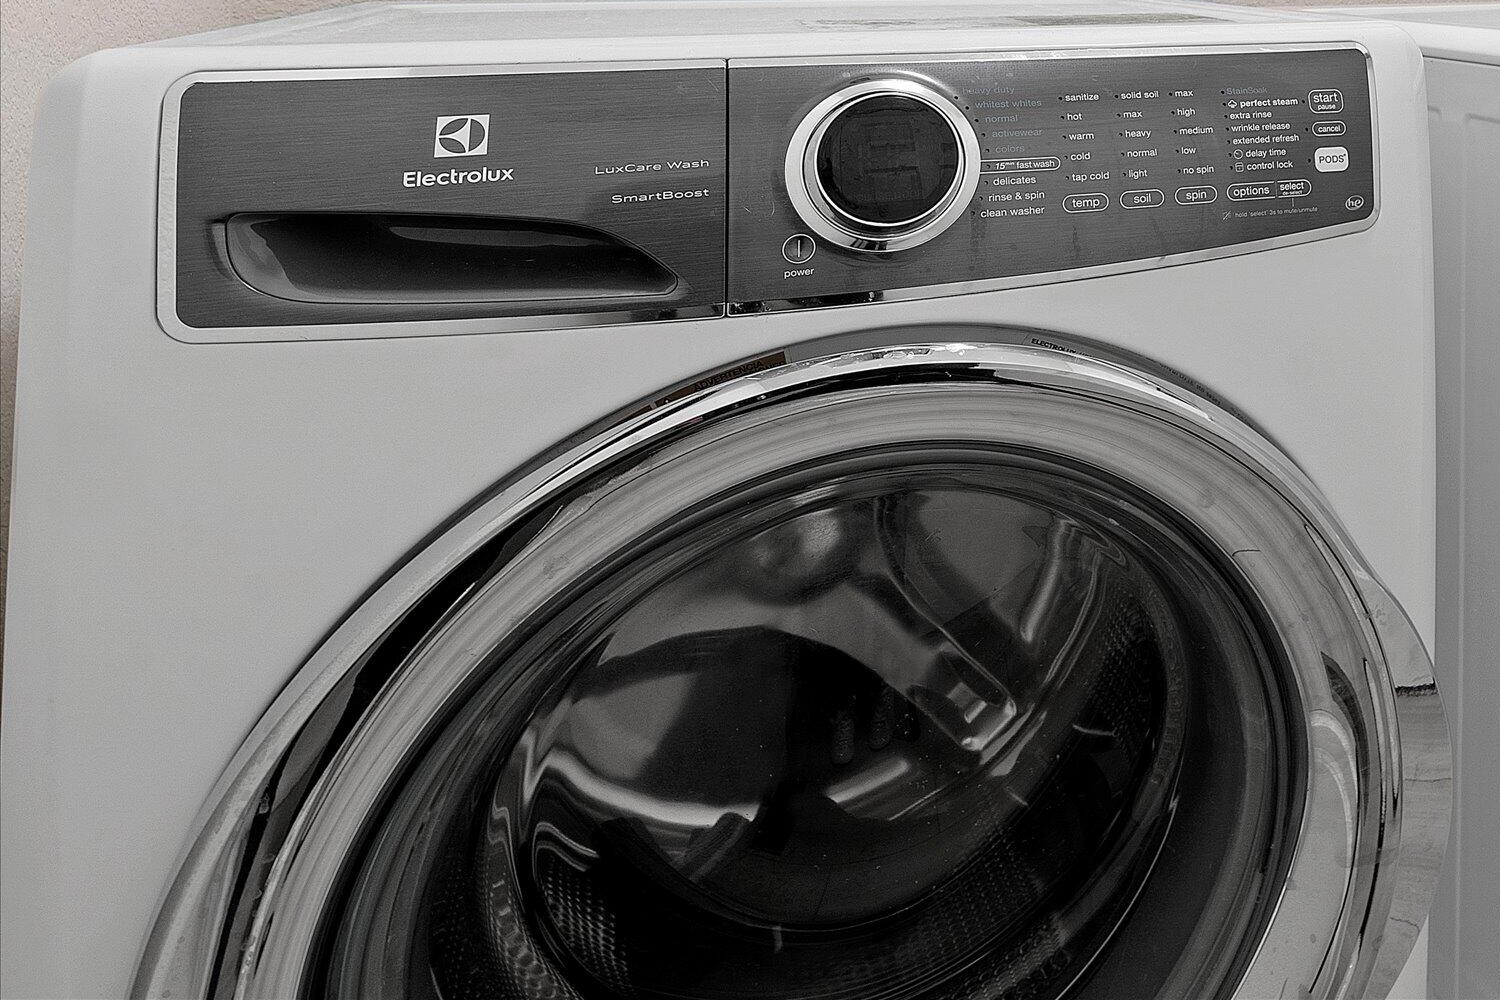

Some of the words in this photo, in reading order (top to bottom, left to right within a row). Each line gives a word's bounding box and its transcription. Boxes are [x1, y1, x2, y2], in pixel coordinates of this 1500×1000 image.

[962, 86, 992, 96] heavy
[1120, 90, 1143, 100] solid
[1143, 89, 1160, 99] soil
[1174, 89, 1194, 98] max
[1226, 85, 1268, 96] StainSoak
[1065, 92, 1100, 102] sanitize
[1312, 92, 1339, 104] start
[975, 100, 1009, 109] whitest
[1011, 98, 1042, 108] whites
[1239, 98, 1271, 109] perfect
[1272, 97, 1299, 107] steam
[1317, 103, 1336, 111] pause
[1067, 112, 1083, 121] hot
[1122, 110, 1143, 119] max
[1177, 107, 1196, 118] high
[1229, 111, 1250, 120] extra
[1251, 110, 1273, 119] rinse
[985, 114, 1018, 123] normal
[1179, 125, 1214, 135] medium
[1231, 123, 1260, 132] wrinkle
[1261, 121, 1291, 131] release
[1317, 124, 1341, 133] cancel
[991, 128, 1043, 138] activewear
[1068, 131, 1095, 141] warm
[1124, 129, 1152, 140] heavy
[1232, 135, 1271, 145] extended
[1272, 133, 1300, 143] refresh
[995, 144, 1025, 153] colors
[1126, 148, 1158, 158] normal
[1181, 146, 1197, 155] low
[1245, 149, 1267, 159] delay
[1268, 147, 1287, 157] time
[1070, 152, 1091, 161] cold
[594, 160, 663, 176] LuxCare
[666, 157, 710, 171] Wash
[1016, 160, 1032, 169] fast
[1033, 159, 1056, 169] wash
[1246, 161, 1275, 171] control
[1276, 160, 1294, 169] lock
[402, 163, 515, 188] Electrolux
[1128, 168, 1148, 180] light
[1183, 166, 1195, 175] no
[1196, 164, 1215, 176] spin
[992, 176, 1037, 186] delicates
[1071, 173, 1088, 184] tap
[1089, 171, 1110, 181] cold
[1185, 189, 1207, 201] spin
[1233, 186, 1270, 198] options
[1279, 181, 1305, 191] select
[610, 186, 711, 205] SmartBoost
[988, 192, 1013, 202] rinse
[1015, 191, 1023, 201] &
[1024, 191, 1046, 203] spin
[1133, 193, 1152, 204] soil
[1071, 197, 1101, 210] temp
[980, 208, 1007, 218] clean
[1009, 206, 1045, 216] washer
[783, 267, 815, 280] power
